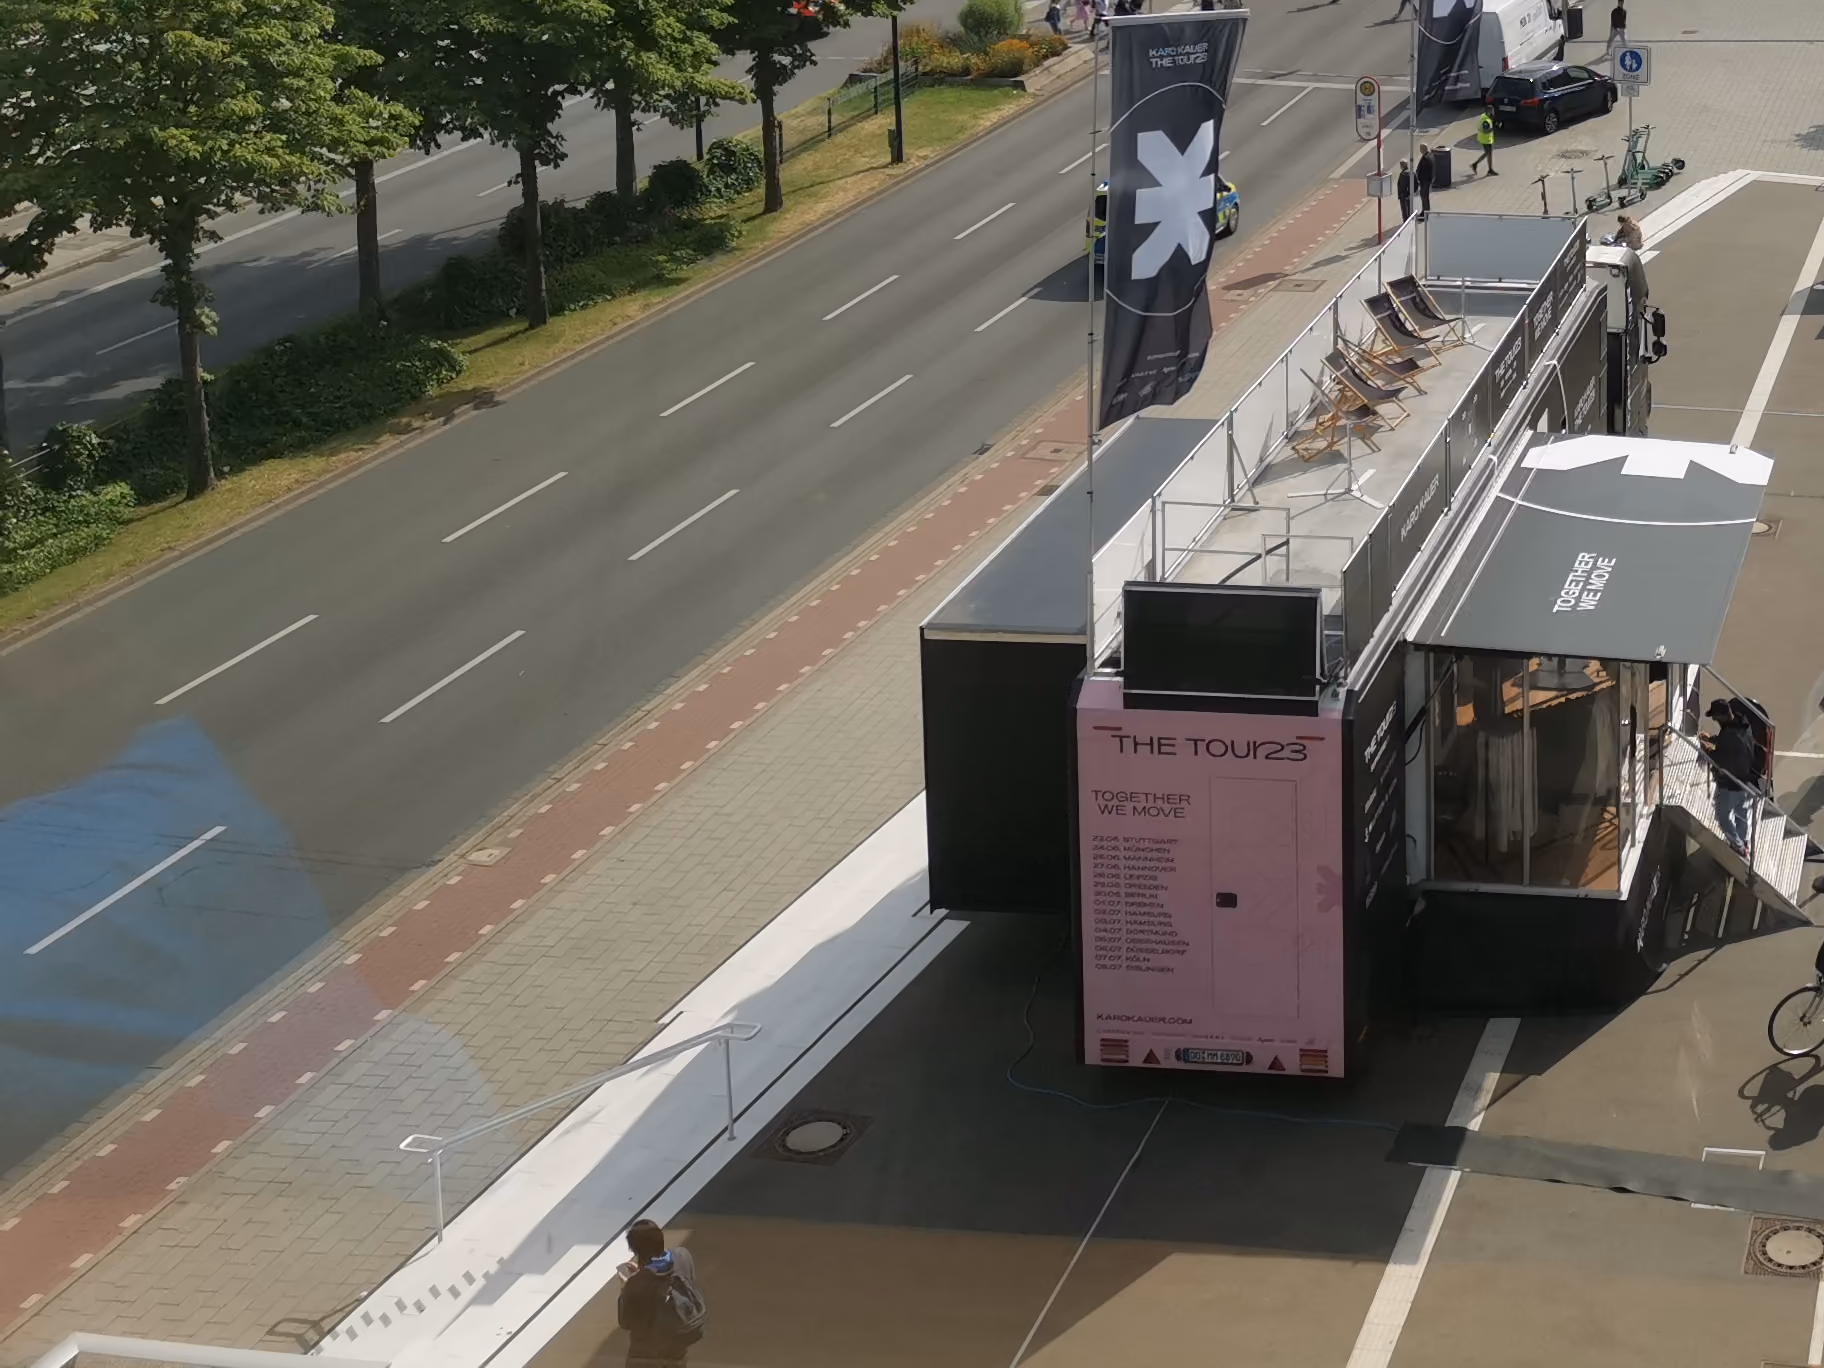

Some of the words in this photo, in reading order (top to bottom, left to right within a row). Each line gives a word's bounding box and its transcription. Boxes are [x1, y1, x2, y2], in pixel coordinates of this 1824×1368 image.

[1150, 56, 1173, 68] THE
[1622, 73, 1640, 81] ZONE
[1553, 552, 1597, 613] TOGETHER
[1586, 557, 1617, 593] MOVE
[1577, 587, 1597, 611] WE
[1111, 735, 1177, 756] THE
[1091, 789, 1191, 805] TOGETHER
[1097, 804, 1127, 816] WE
[1132, 805, 1186, 819] MOVE
